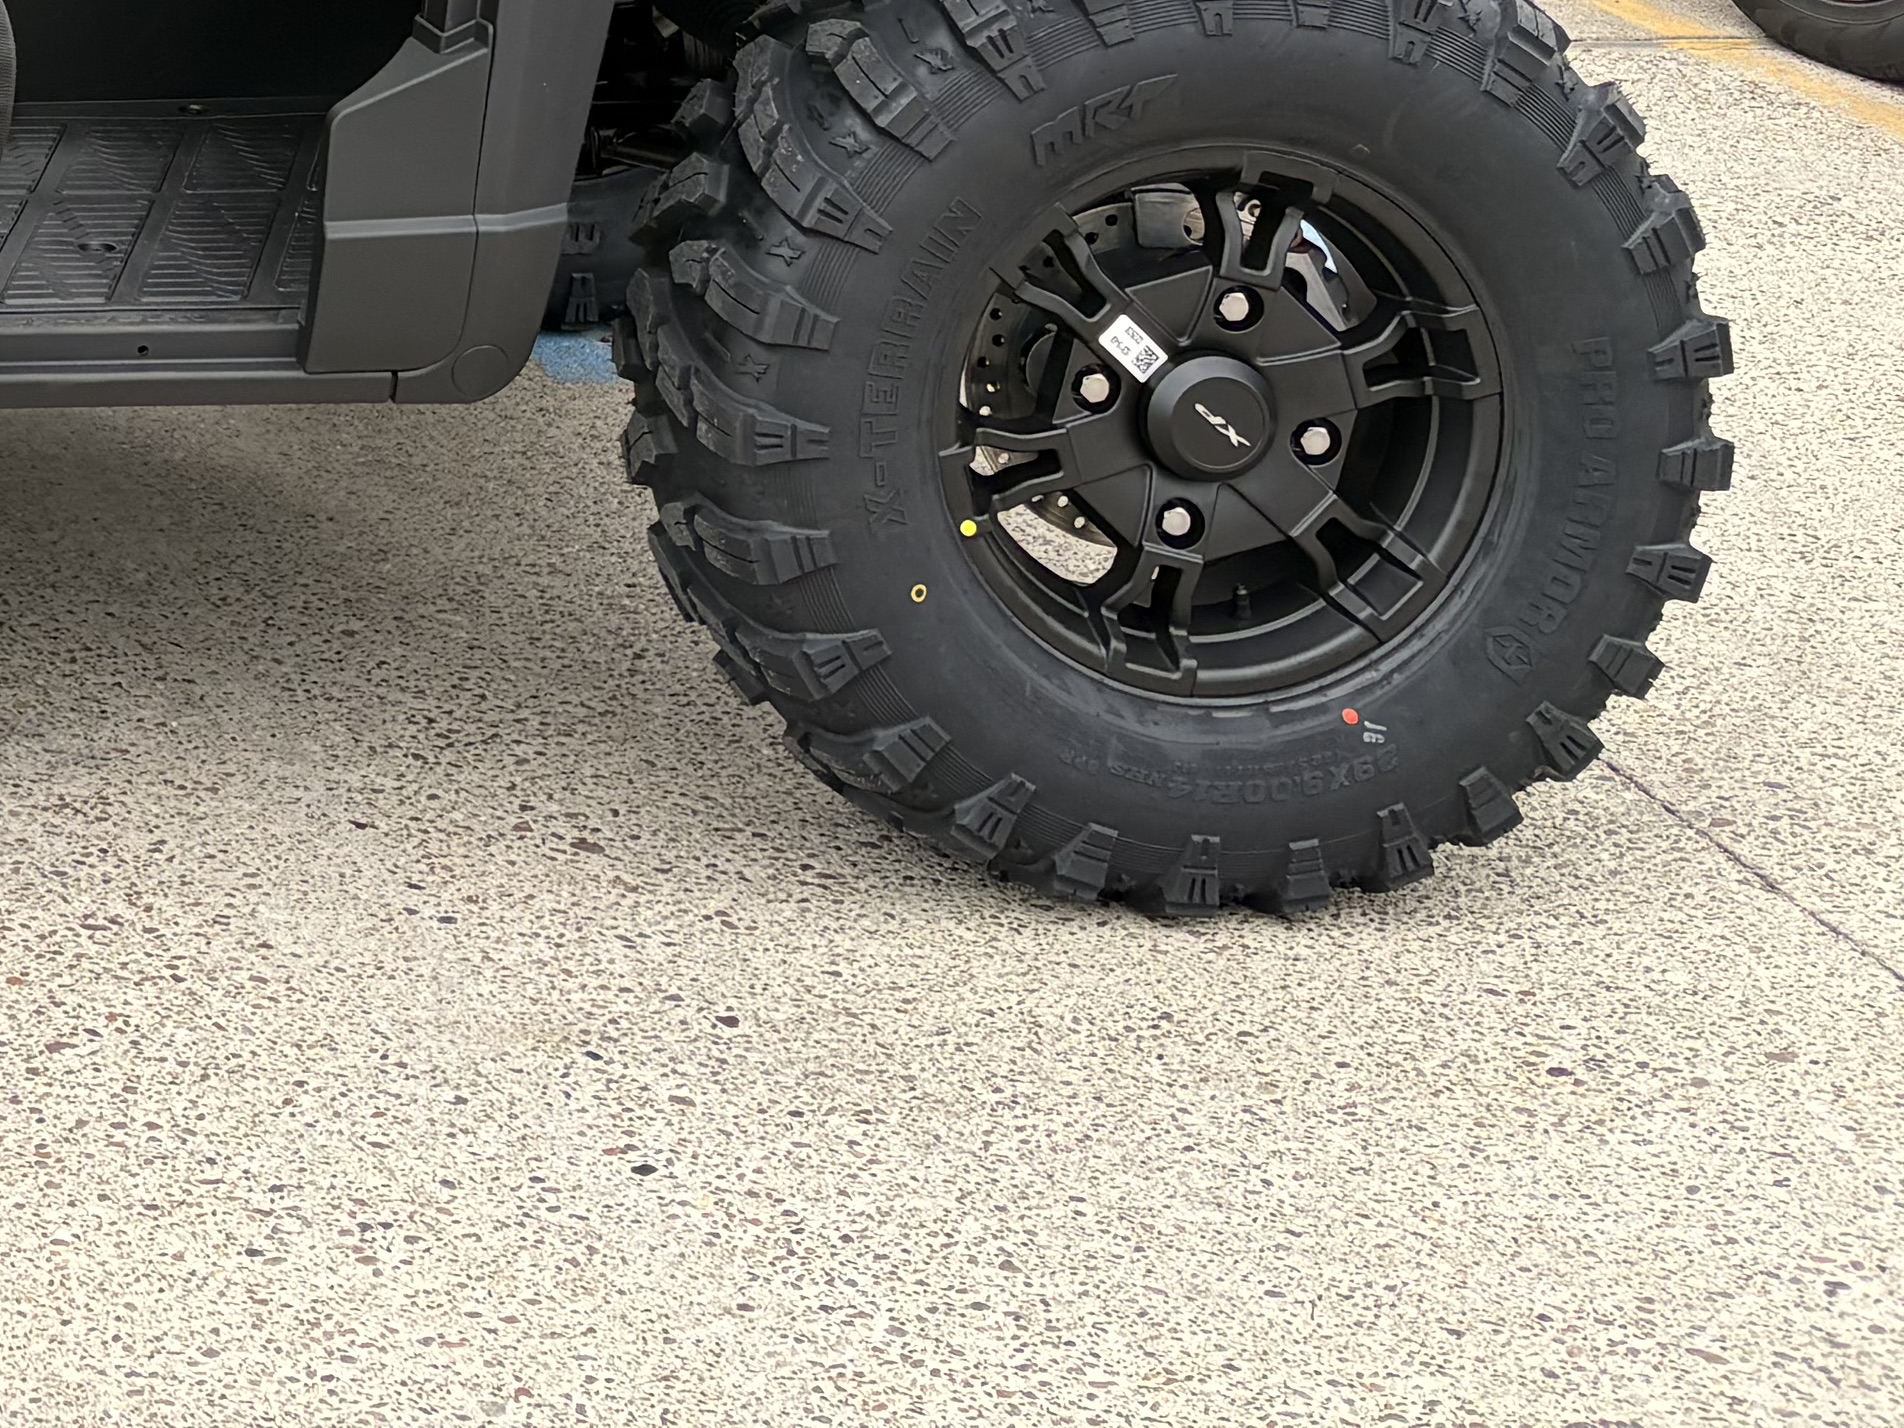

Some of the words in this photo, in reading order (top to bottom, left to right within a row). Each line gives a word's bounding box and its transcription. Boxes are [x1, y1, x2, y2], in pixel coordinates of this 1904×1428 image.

[859, 196, 982, 535] X-TERRAIN
[1194, 402, 1252, 448] XP
[1572, 336, 1617, 440] PRO
[1518, 450, 1617, 635] ARMOR
